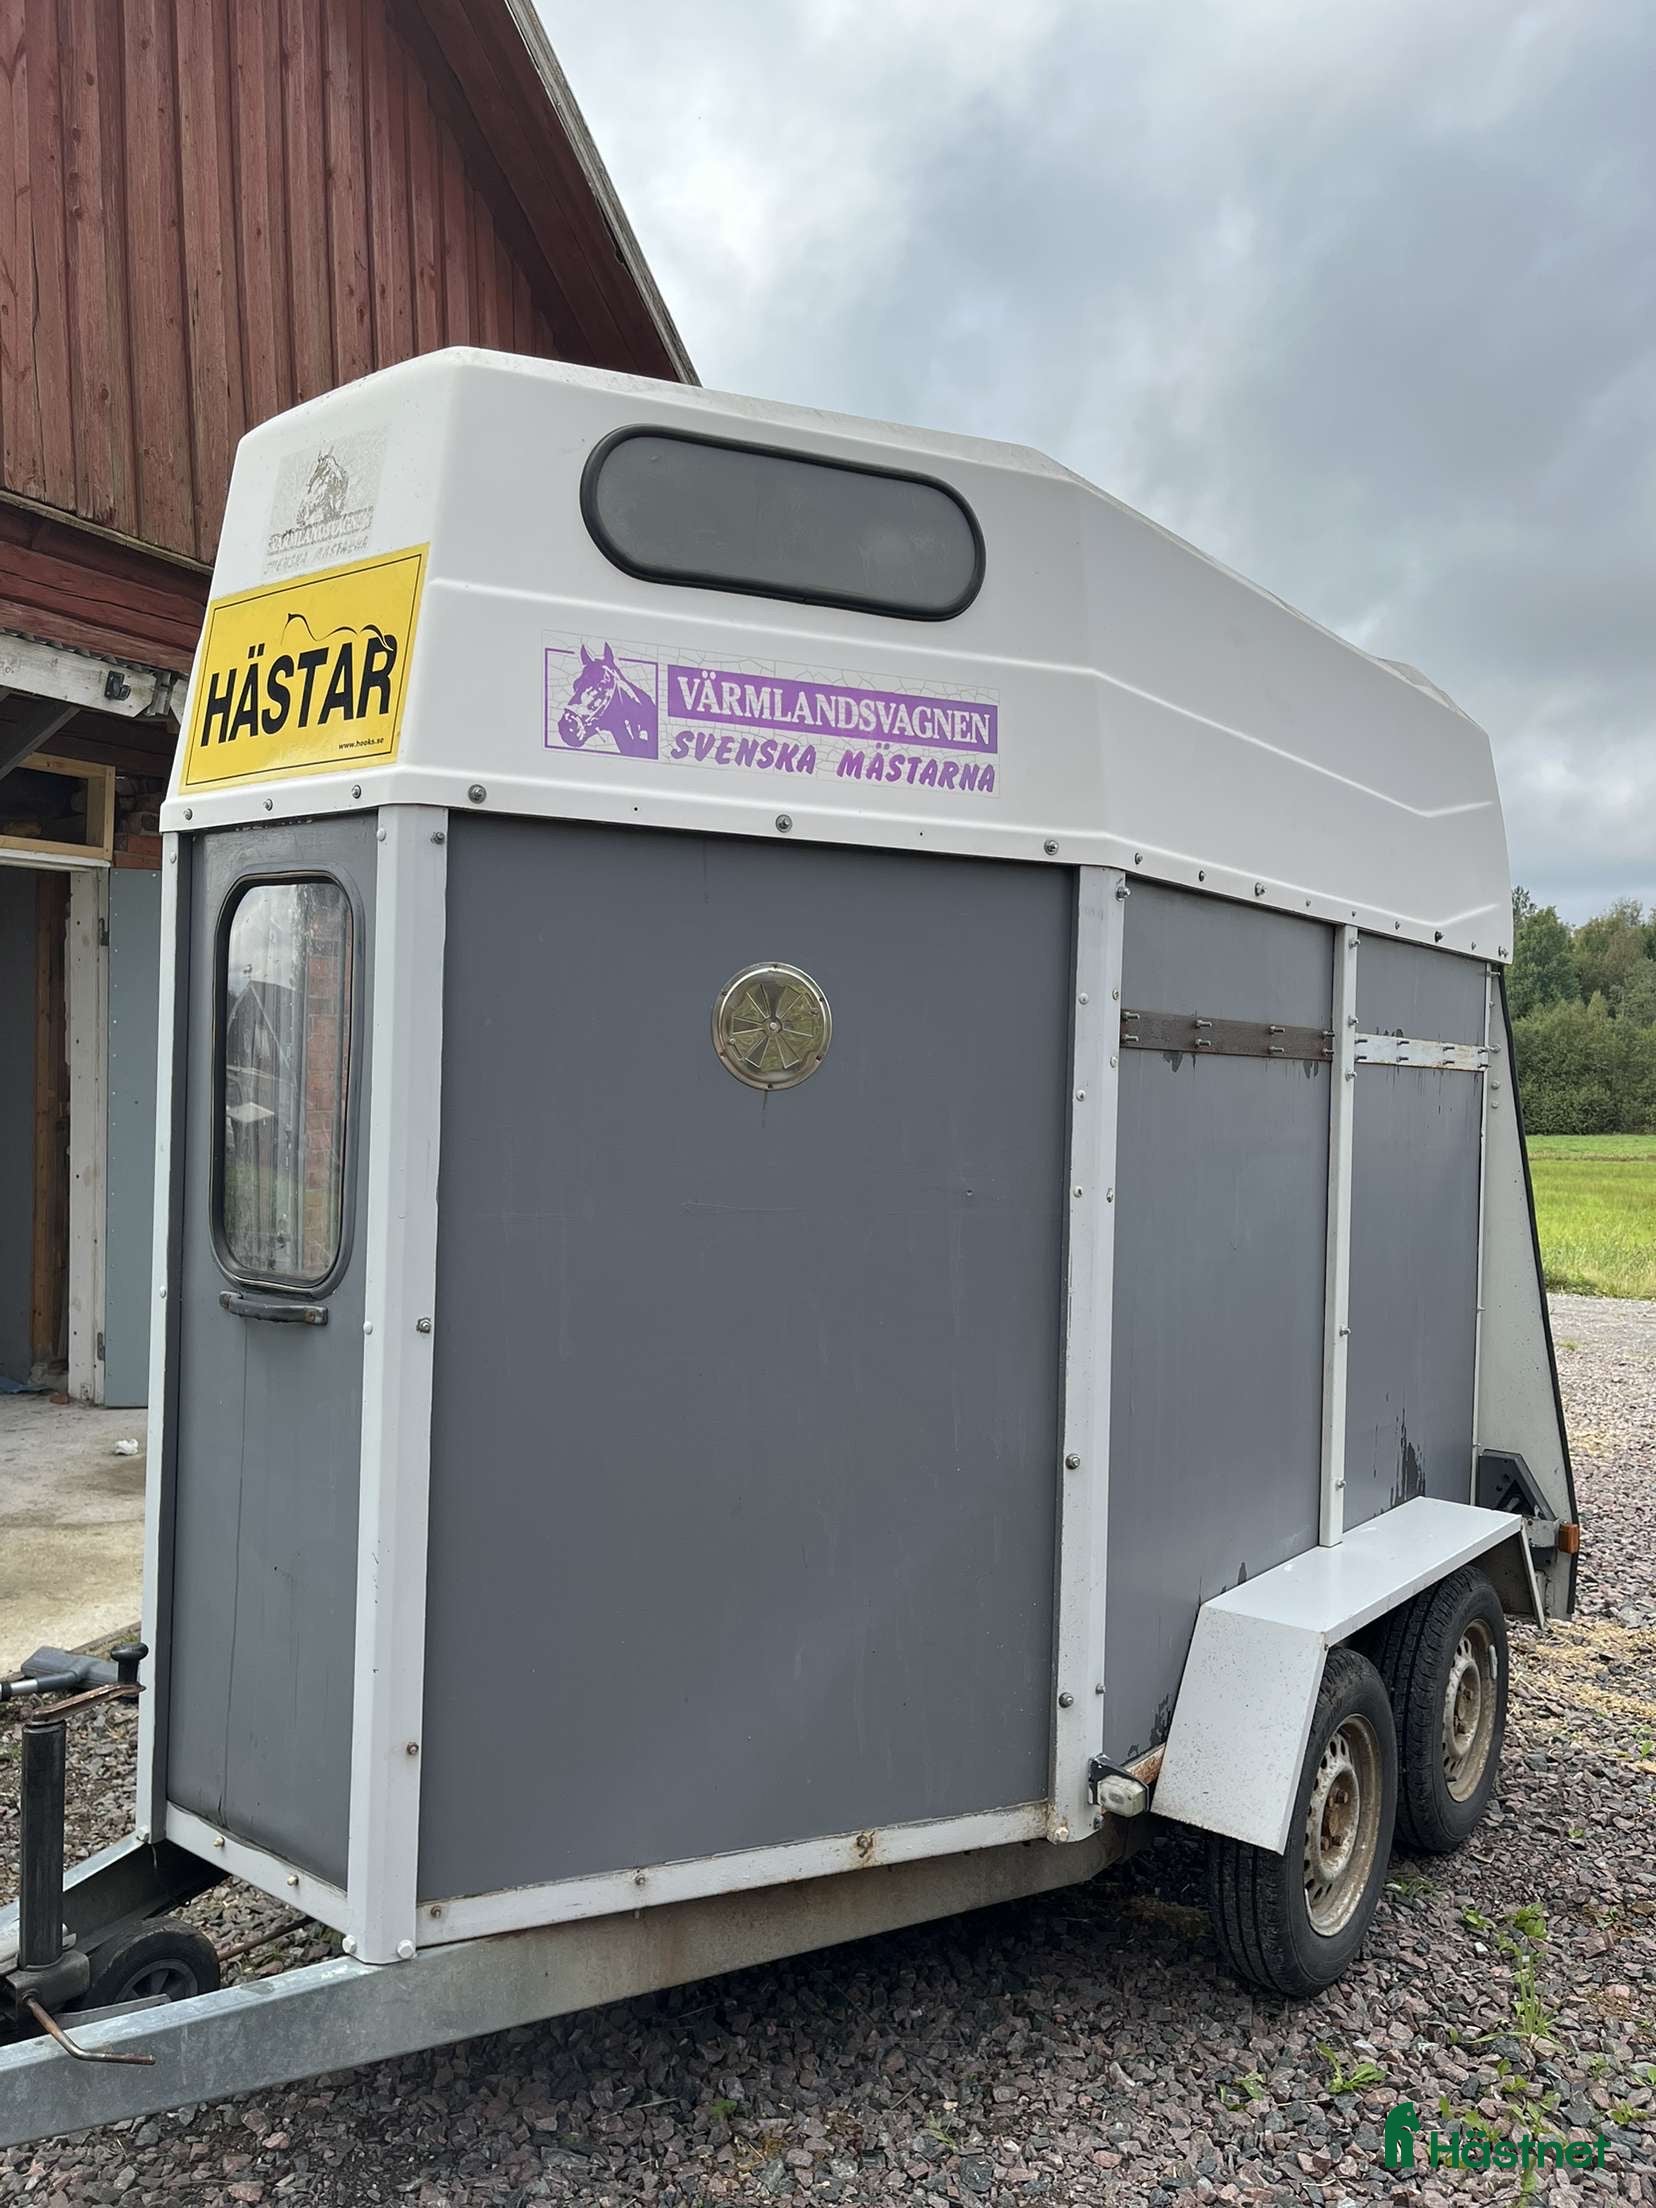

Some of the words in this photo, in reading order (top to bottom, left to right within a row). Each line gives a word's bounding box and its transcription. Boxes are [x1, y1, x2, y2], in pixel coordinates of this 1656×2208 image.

[200, 634, 398, 747] HÄSTAR
[677, 671, 990, 745] VÄRMLANDSVAGNEN
[338, 737, 385, 750] www.hooks.se
[670, 730, 816, 774] SVENSKA
[837, 743, 996, 793] MÄSTARNA
